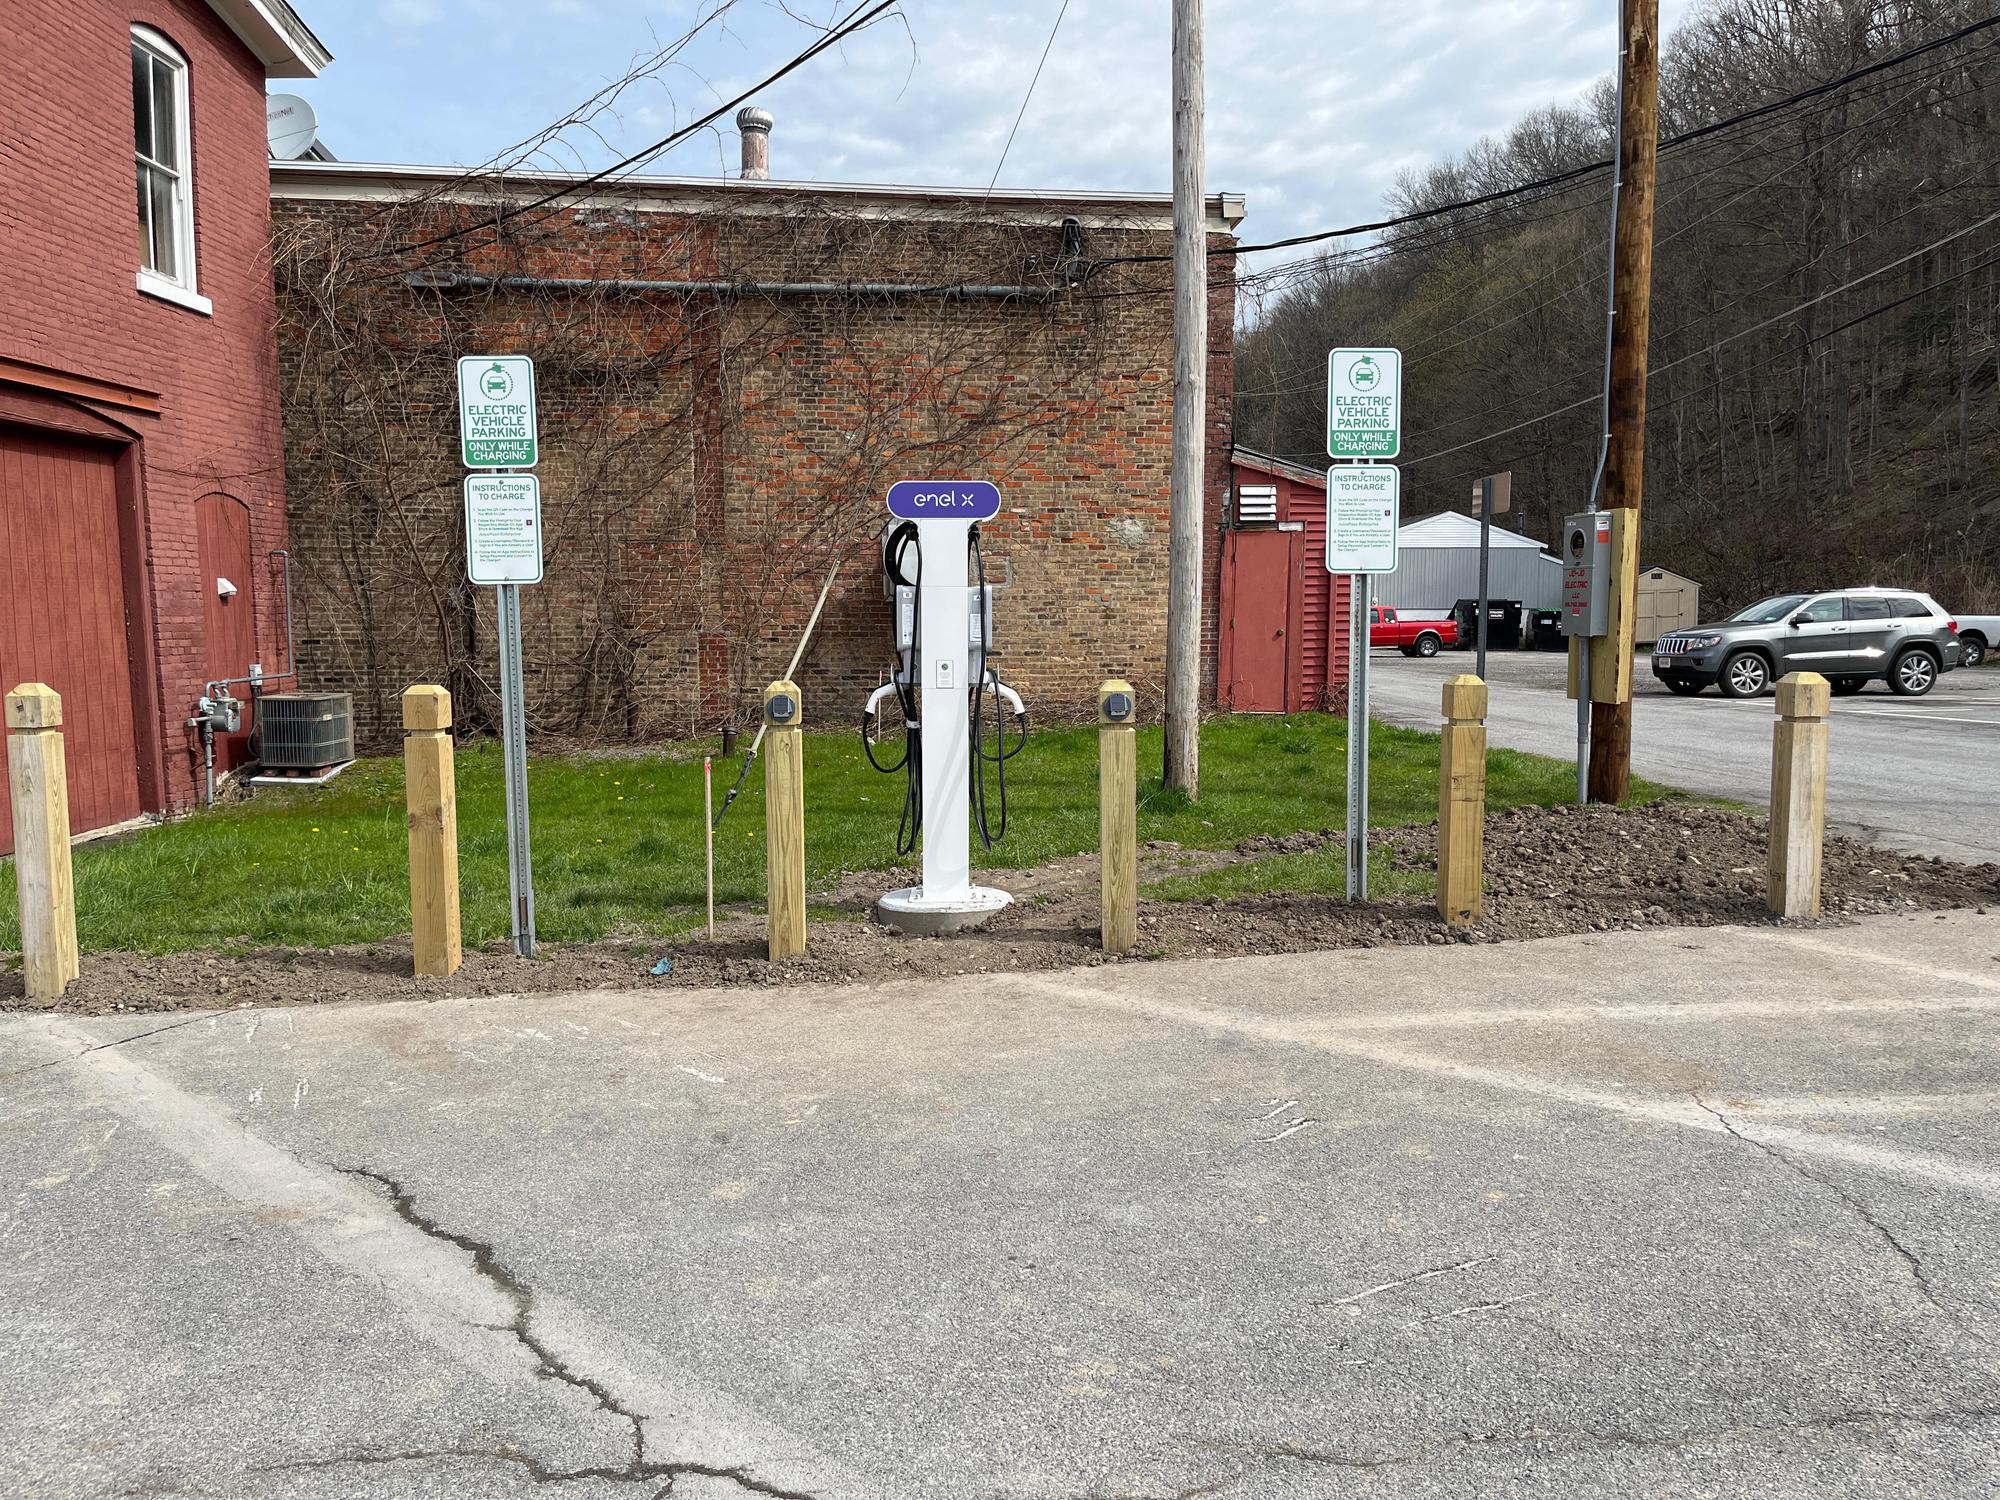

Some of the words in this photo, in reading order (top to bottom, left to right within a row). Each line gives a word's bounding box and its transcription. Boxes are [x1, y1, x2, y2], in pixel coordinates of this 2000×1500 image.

[1336, 396, 1392, 406] ELECTRIC
[468, 405, 526, 415] ELECTRIC
[1339, 408, 1389, 417] VEHICLE
[472, 416, 524, 426] VEHICLE
[1338, 419, 1389, 428] PARKING
[472, 427, 526, 437] PARKING
[1334, 433, 1360, 441] ONLY
[1361, 432, 1392, 441] WHILE
[469, 442, 497, 450] ONLY
[498, 442, 530, 450] WHILE
[1338, 442, 1388, 450] CHARGING
[473, 451, 526, 460] CHARGING
[914, 490, 956, 506] enel
[961, 494, 974, 506] x
